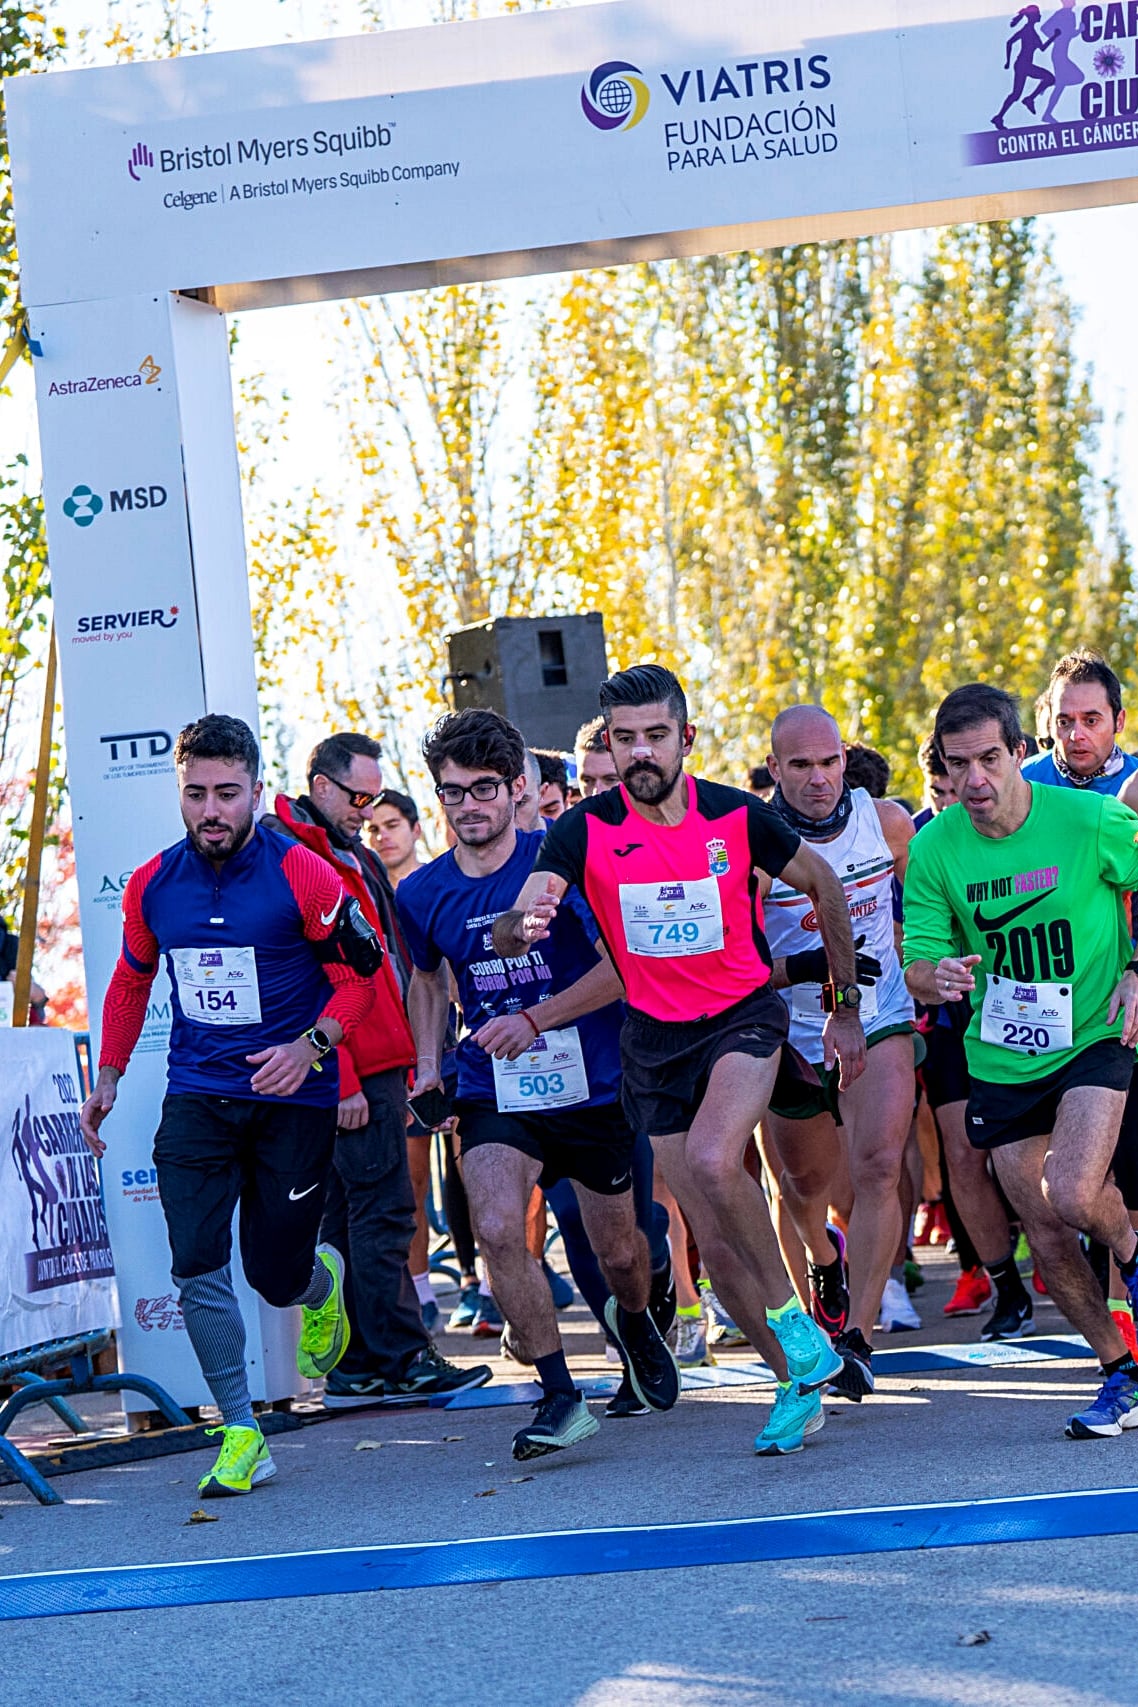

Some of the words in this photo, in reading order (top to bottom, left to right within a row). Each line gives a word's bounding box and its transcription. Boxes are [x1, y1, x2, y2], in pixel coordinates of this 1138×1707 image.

[661, 55, 831, 106] VIATRIS
[664, 100, 836, 147] FUNDACIÓN
[160, 142, 232, 172] Bristol
[237, 136, 308, 165] Myers
[667, 147, 726, 171] PARA
[732, 142, 759, 163] LA
[764, 133, 838, 160] SALUD
[998, 131, 1058, 155] CONTRA
[1061, 129, 1079, 148] EL
[163, 188, 218, 211] Celgene
[229, 186, 241, 201] A
[243, 179, 288, 198] Bristol
[292, 175, 337, 195] Myers
[340, 163, 390, 188] Squibb
[391, 160, 460, 182] Company
[48, 374, 142, 397] AstraZeneca
[110, 486, 167, 512] MSD
[77, 609, 177, 633] SERVIER
[72, 632, 101, 644] moved
[103, 632, 114, 642] by
[116, 631, 133, 641] you
[100, 731, 171, 760] TTD
[967, 881, 989, 903] WHY
[991, 876, 1012, 899] NOT
[1014, 866, 1059, 895] FASTER?
[648, 922, 699, 944] 749
[469, 959, 505, 976] CORRO
[505, 954, 532, 971] POR
[530, 950, 544, 965] TI
[985, 918, 1074, 983] 2019
[473, 974, 509, 991] CORRO
[509, 968, 534, 986] POR
[195, 990, 237, 1010] 154
[1003, 1023, 1050, 1048] 220
[519, 1073, 565, 1097] 503
[122, 1186, 153, 1197] Sociedad
[133, 1194, 141, 1203] de
